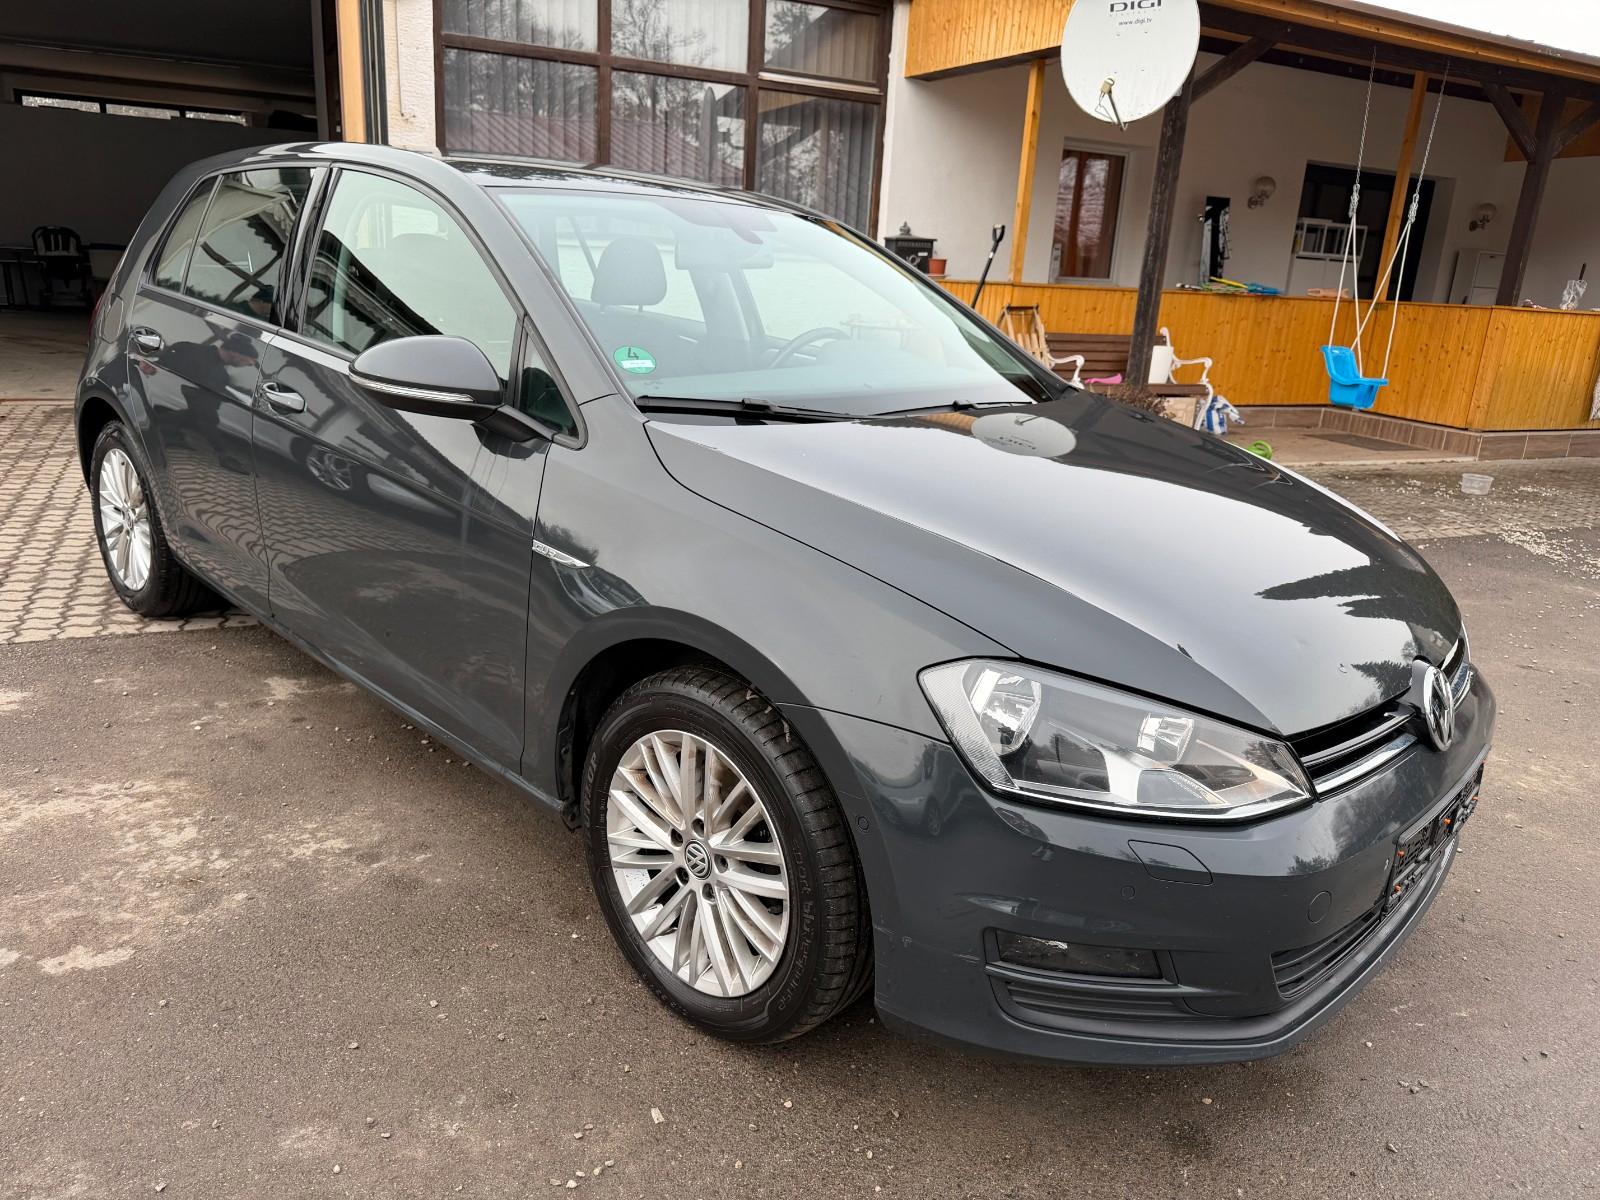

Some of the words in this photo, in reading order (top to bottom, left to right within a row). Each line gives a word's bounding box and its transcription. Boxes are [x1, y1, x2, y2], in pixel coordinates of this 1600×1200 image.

[1110, 0, 1161, 12] DIGI
[1118, 17, 1152, 26] www.digi.tv
[627, 347, 639, 360] 4
